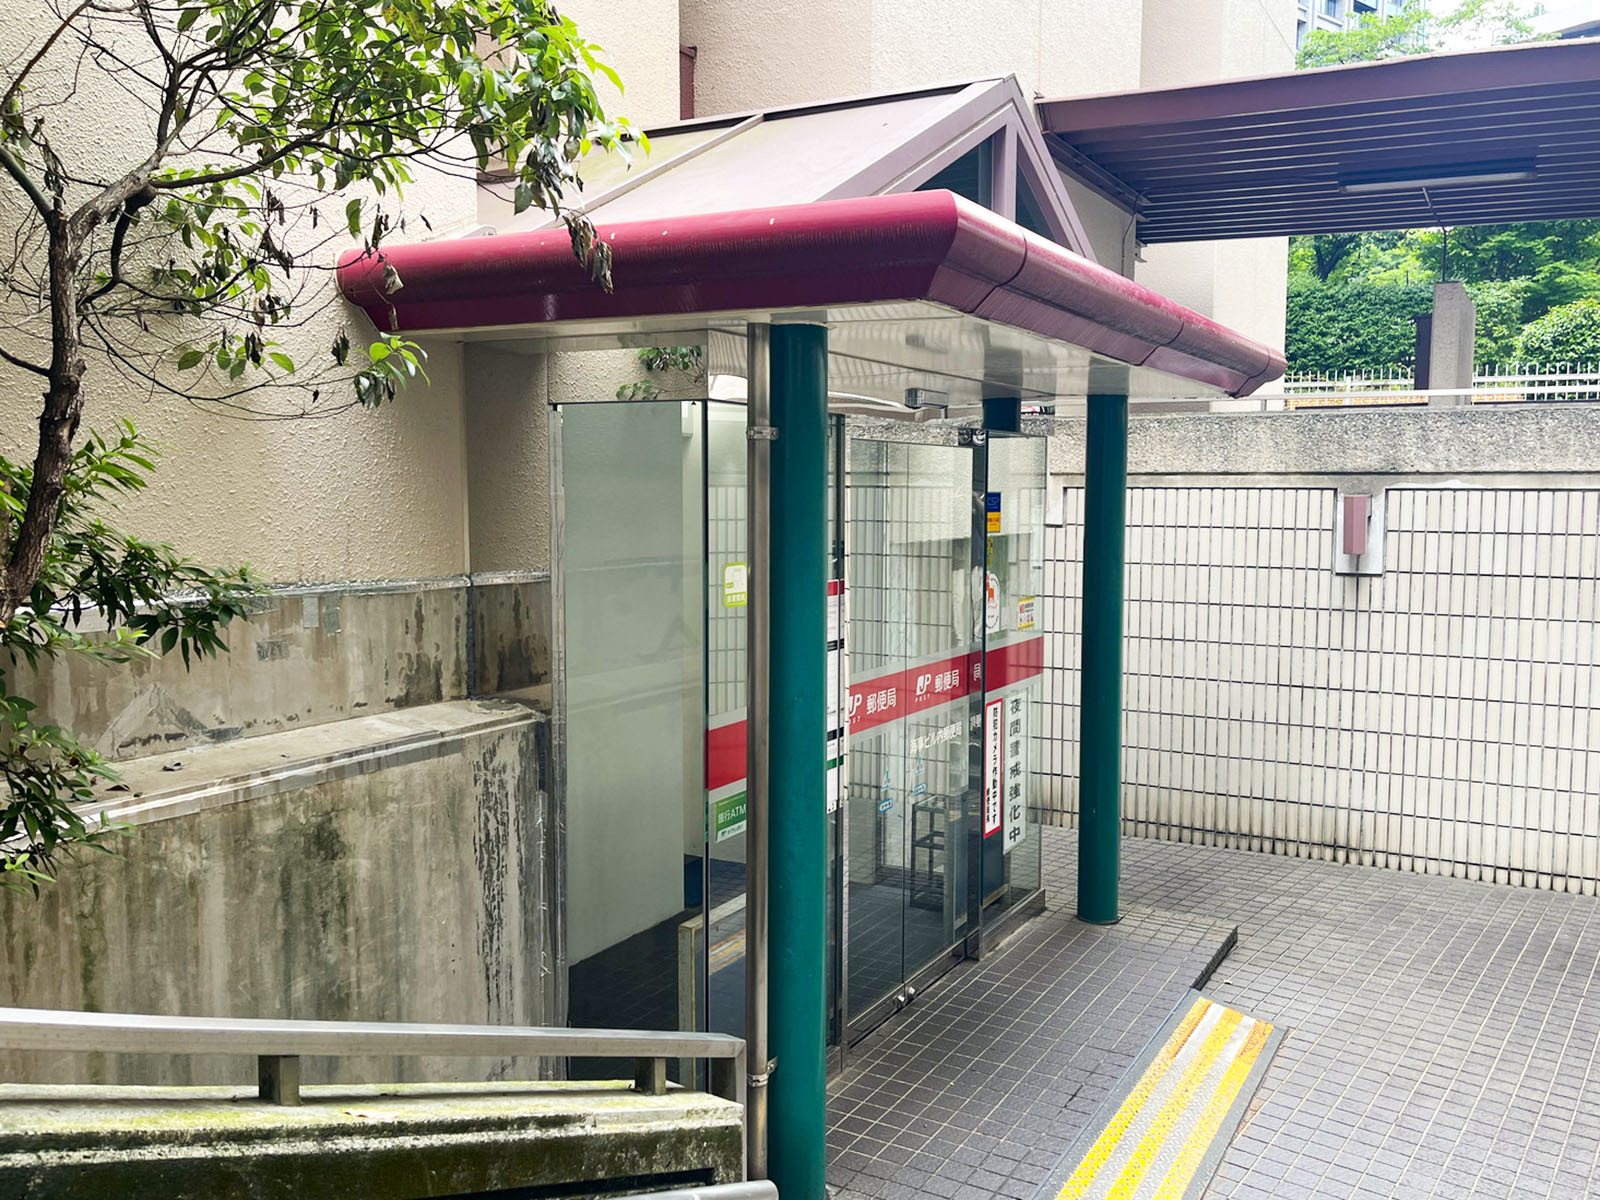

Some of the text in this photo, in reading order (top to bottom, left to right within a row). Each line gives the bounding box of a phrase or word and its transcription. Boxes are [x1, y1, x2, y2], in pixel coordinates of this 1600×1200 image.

[934, 669, 960, 693] 郵便局
[866, 687, 897, 715] 郵便局
[1009, 698, 1022, 841] 夜間警戒強化中
[718, 803, 747, 824] 銀行ATM
